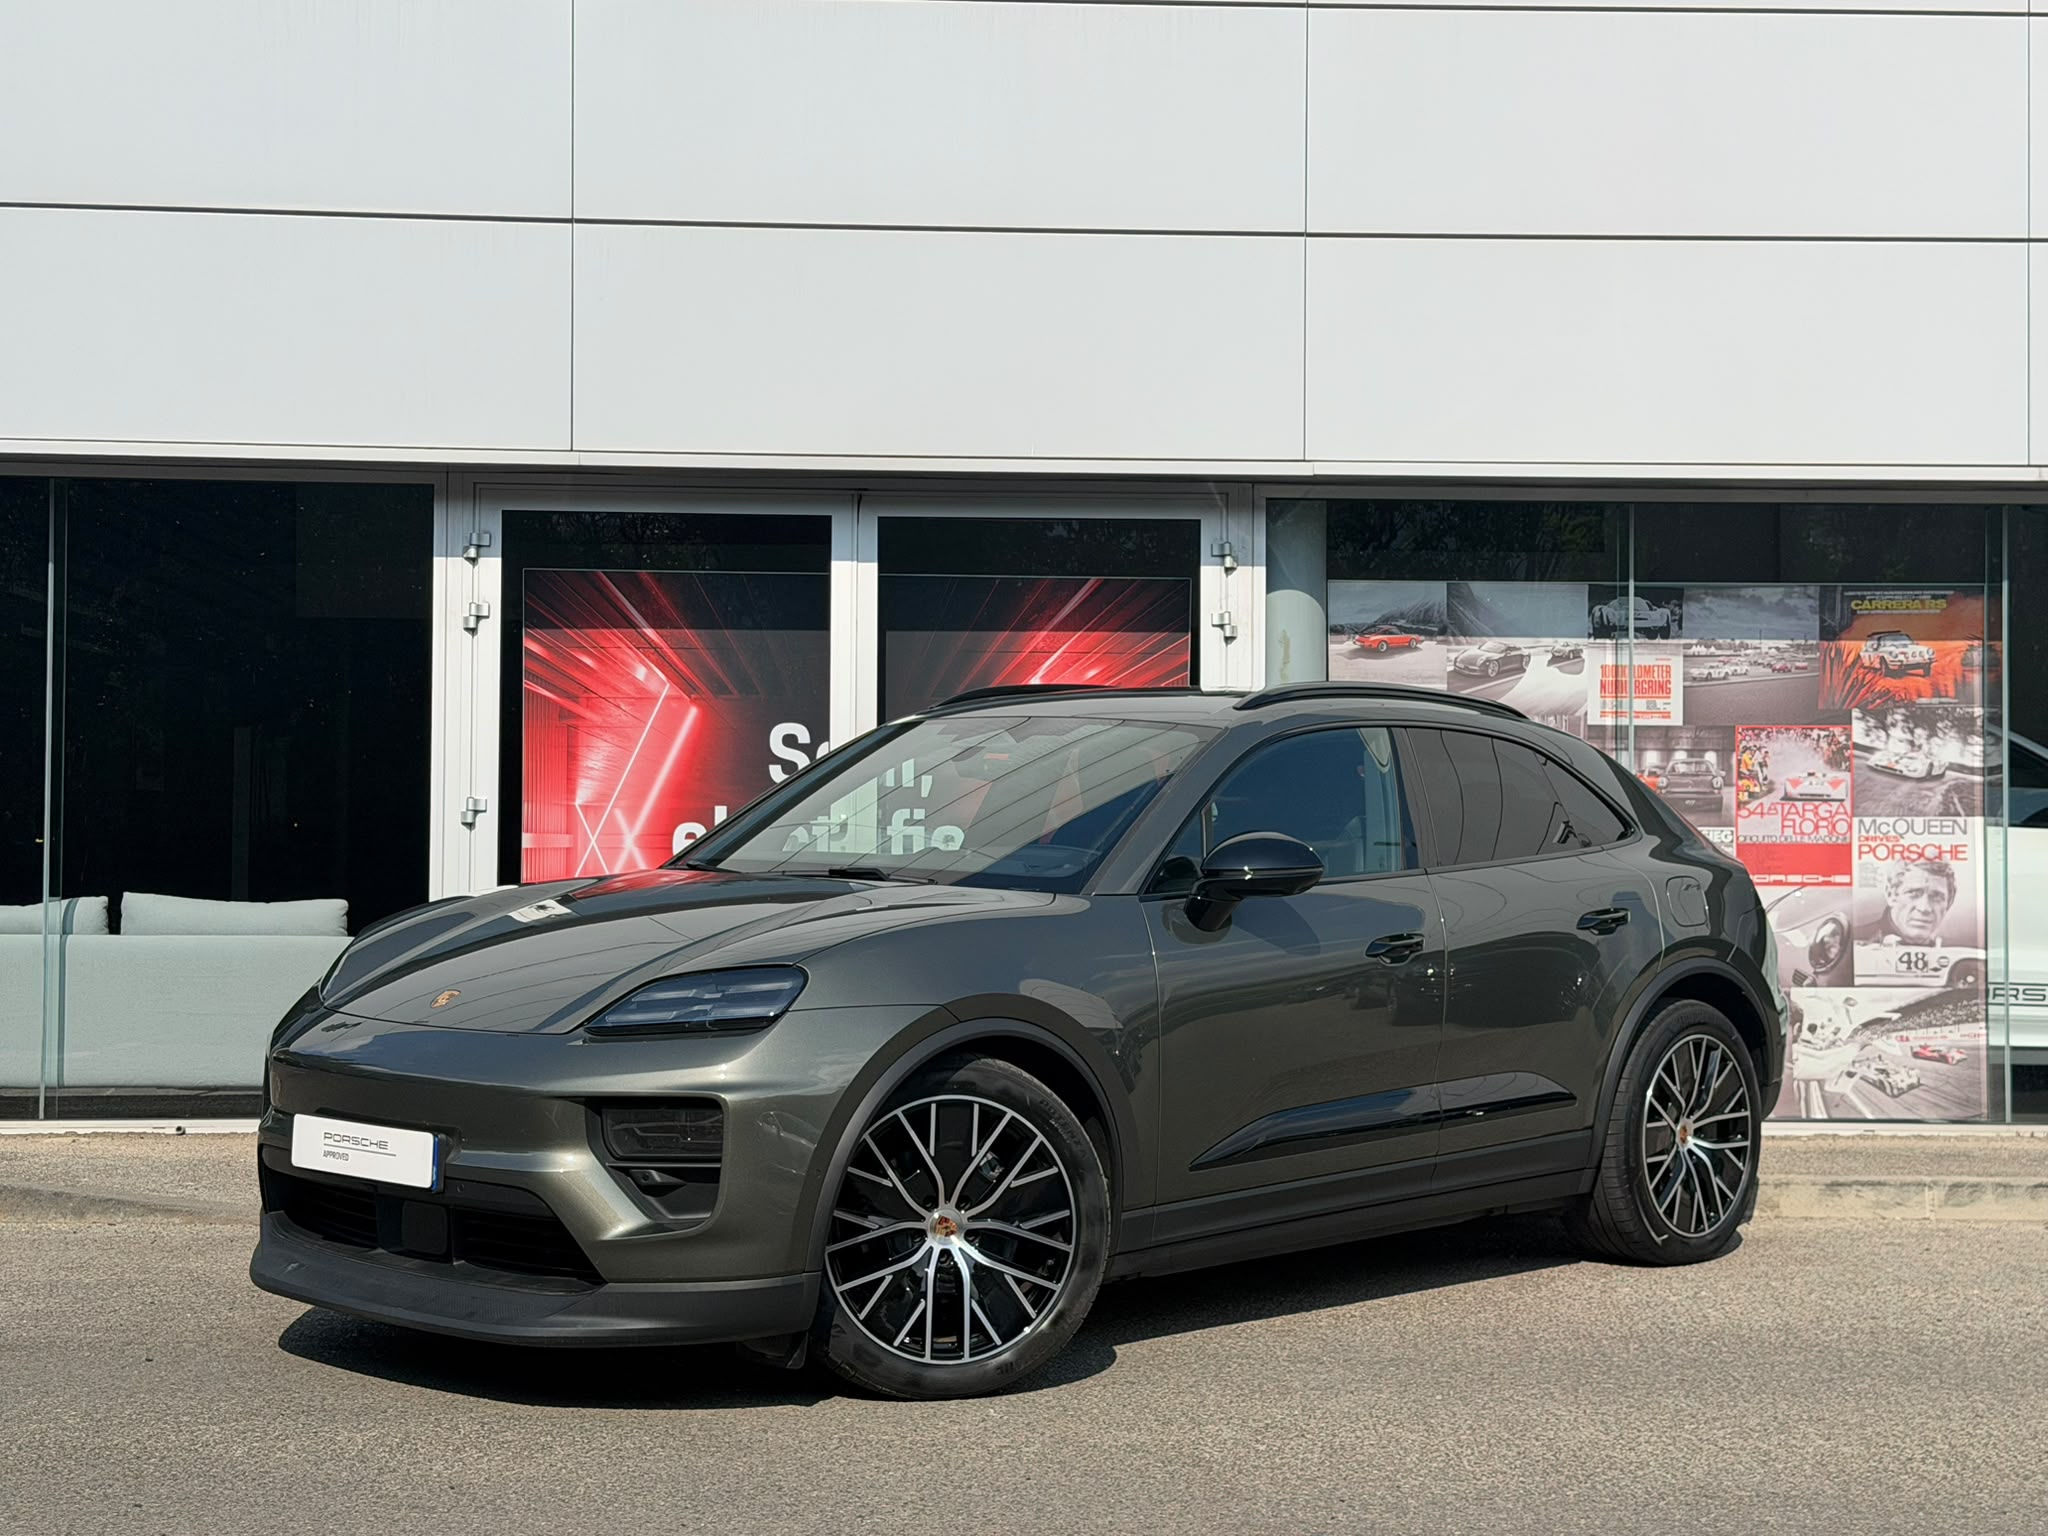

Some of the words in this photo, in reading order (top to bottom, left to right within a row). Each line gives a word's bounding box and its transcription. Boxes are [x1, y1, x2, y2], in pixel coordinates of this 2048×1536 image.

[1851, 599, 1923, 610] CARRERA
[1924, 599, 1947, 609] RS
[1778, 802, 1849, 818] TARGA
[1782, 818, 1850, 835] FLORIO
[1858, 818, 1967, 838] McQUEEN
[1858, 843, 1968, 861] PORSCHE
[1750, 874, 1851, 883] ORSCHE
[1899, 951, 1928, 970] 48
[323, 1132, 389, 1150] PORSCHE
[322, 1150, 350, 1161] APPROVED
